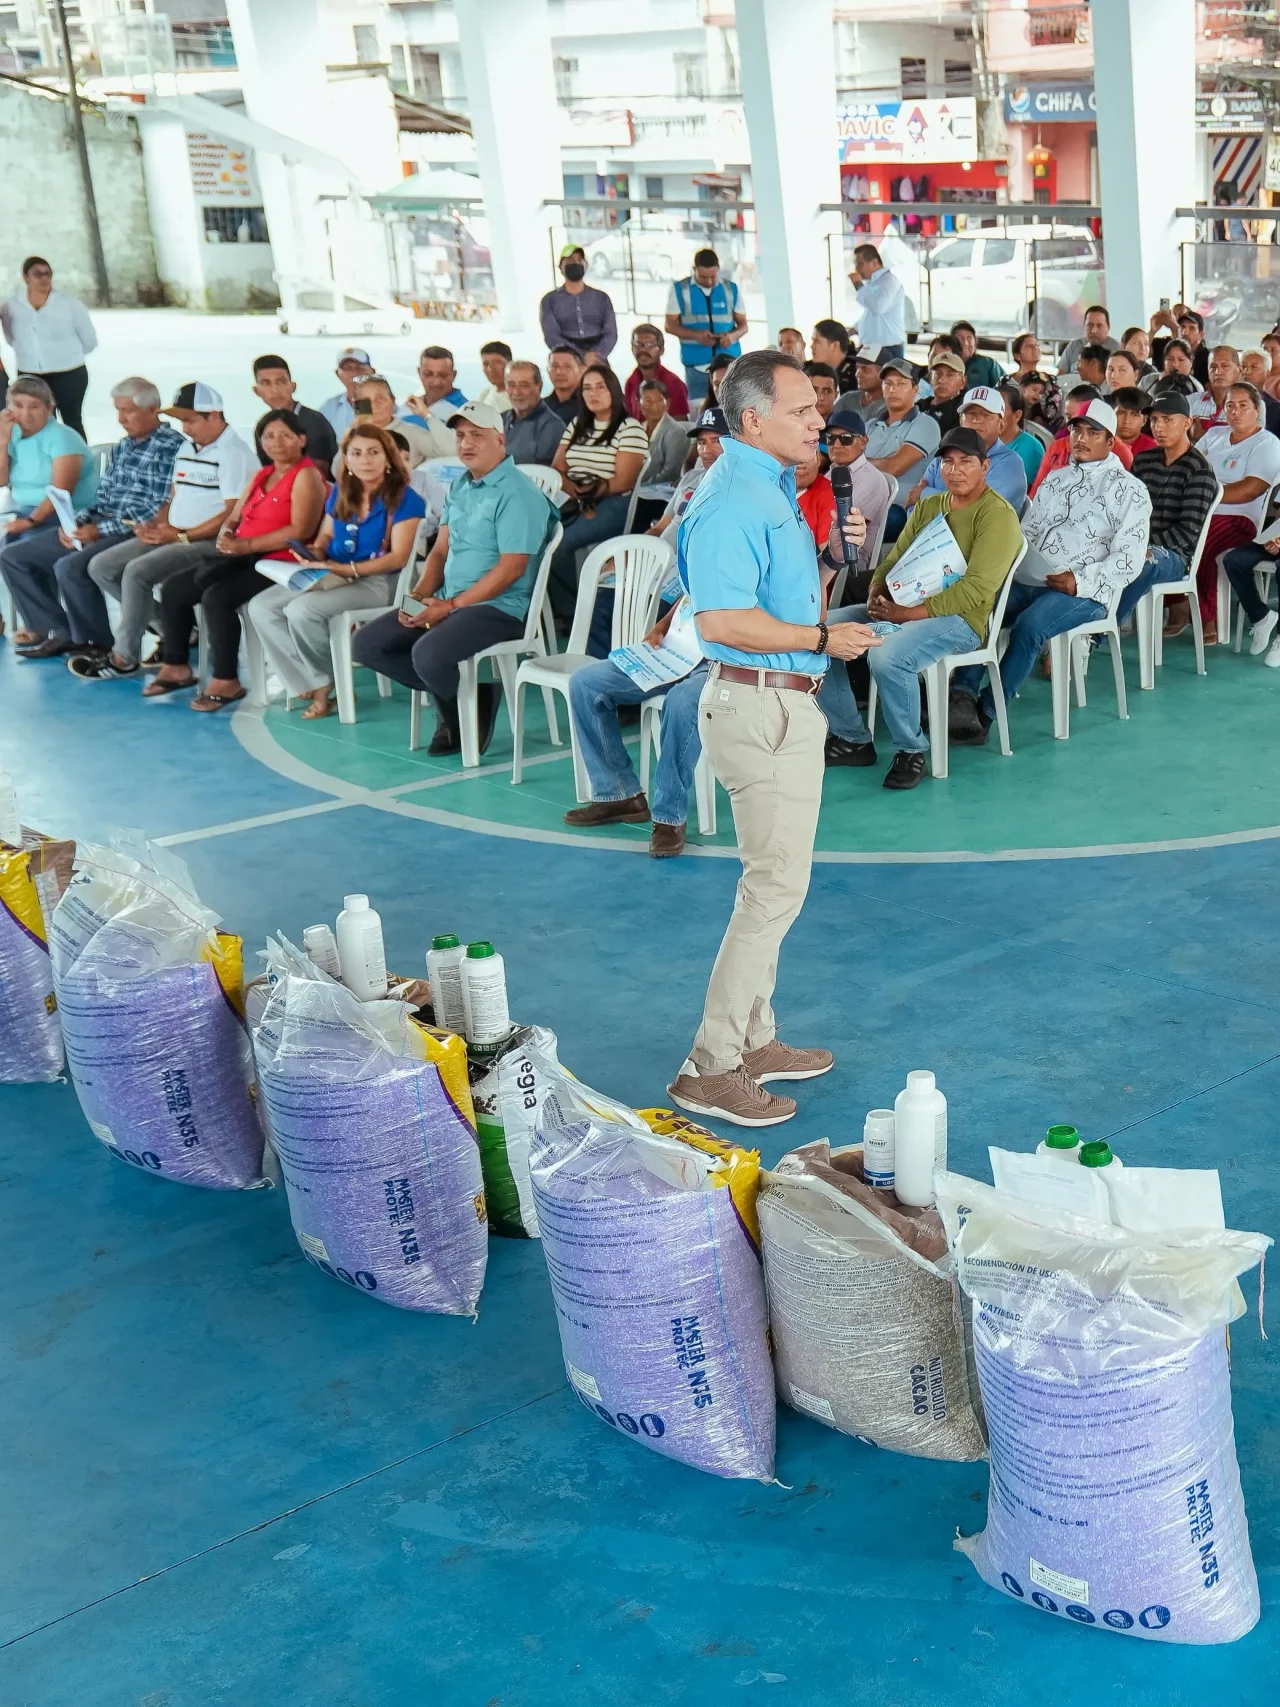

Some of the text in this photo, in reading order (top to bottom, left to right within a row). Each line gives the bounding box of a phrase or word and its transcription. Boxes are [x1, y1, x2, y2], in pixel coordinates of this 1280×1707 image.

[394, 1178, 415, 1226] MASTER
[963, 1257, 1060, 1280] RECOMENDICIÓN DE USO:
[670, 1318, 690, 1371] PROTEC
[682, 1315, 706, 1366] MASTER
[909, 1364, 929, 1416] CACAO
[1060, 1518, 1069, 1526] CL
[1075, 1519, 1089, 1527] 001
[1185, 1485, 1201, 1544] PROTEC
[1195, 1478, 1220, 1589] MASTER N35
